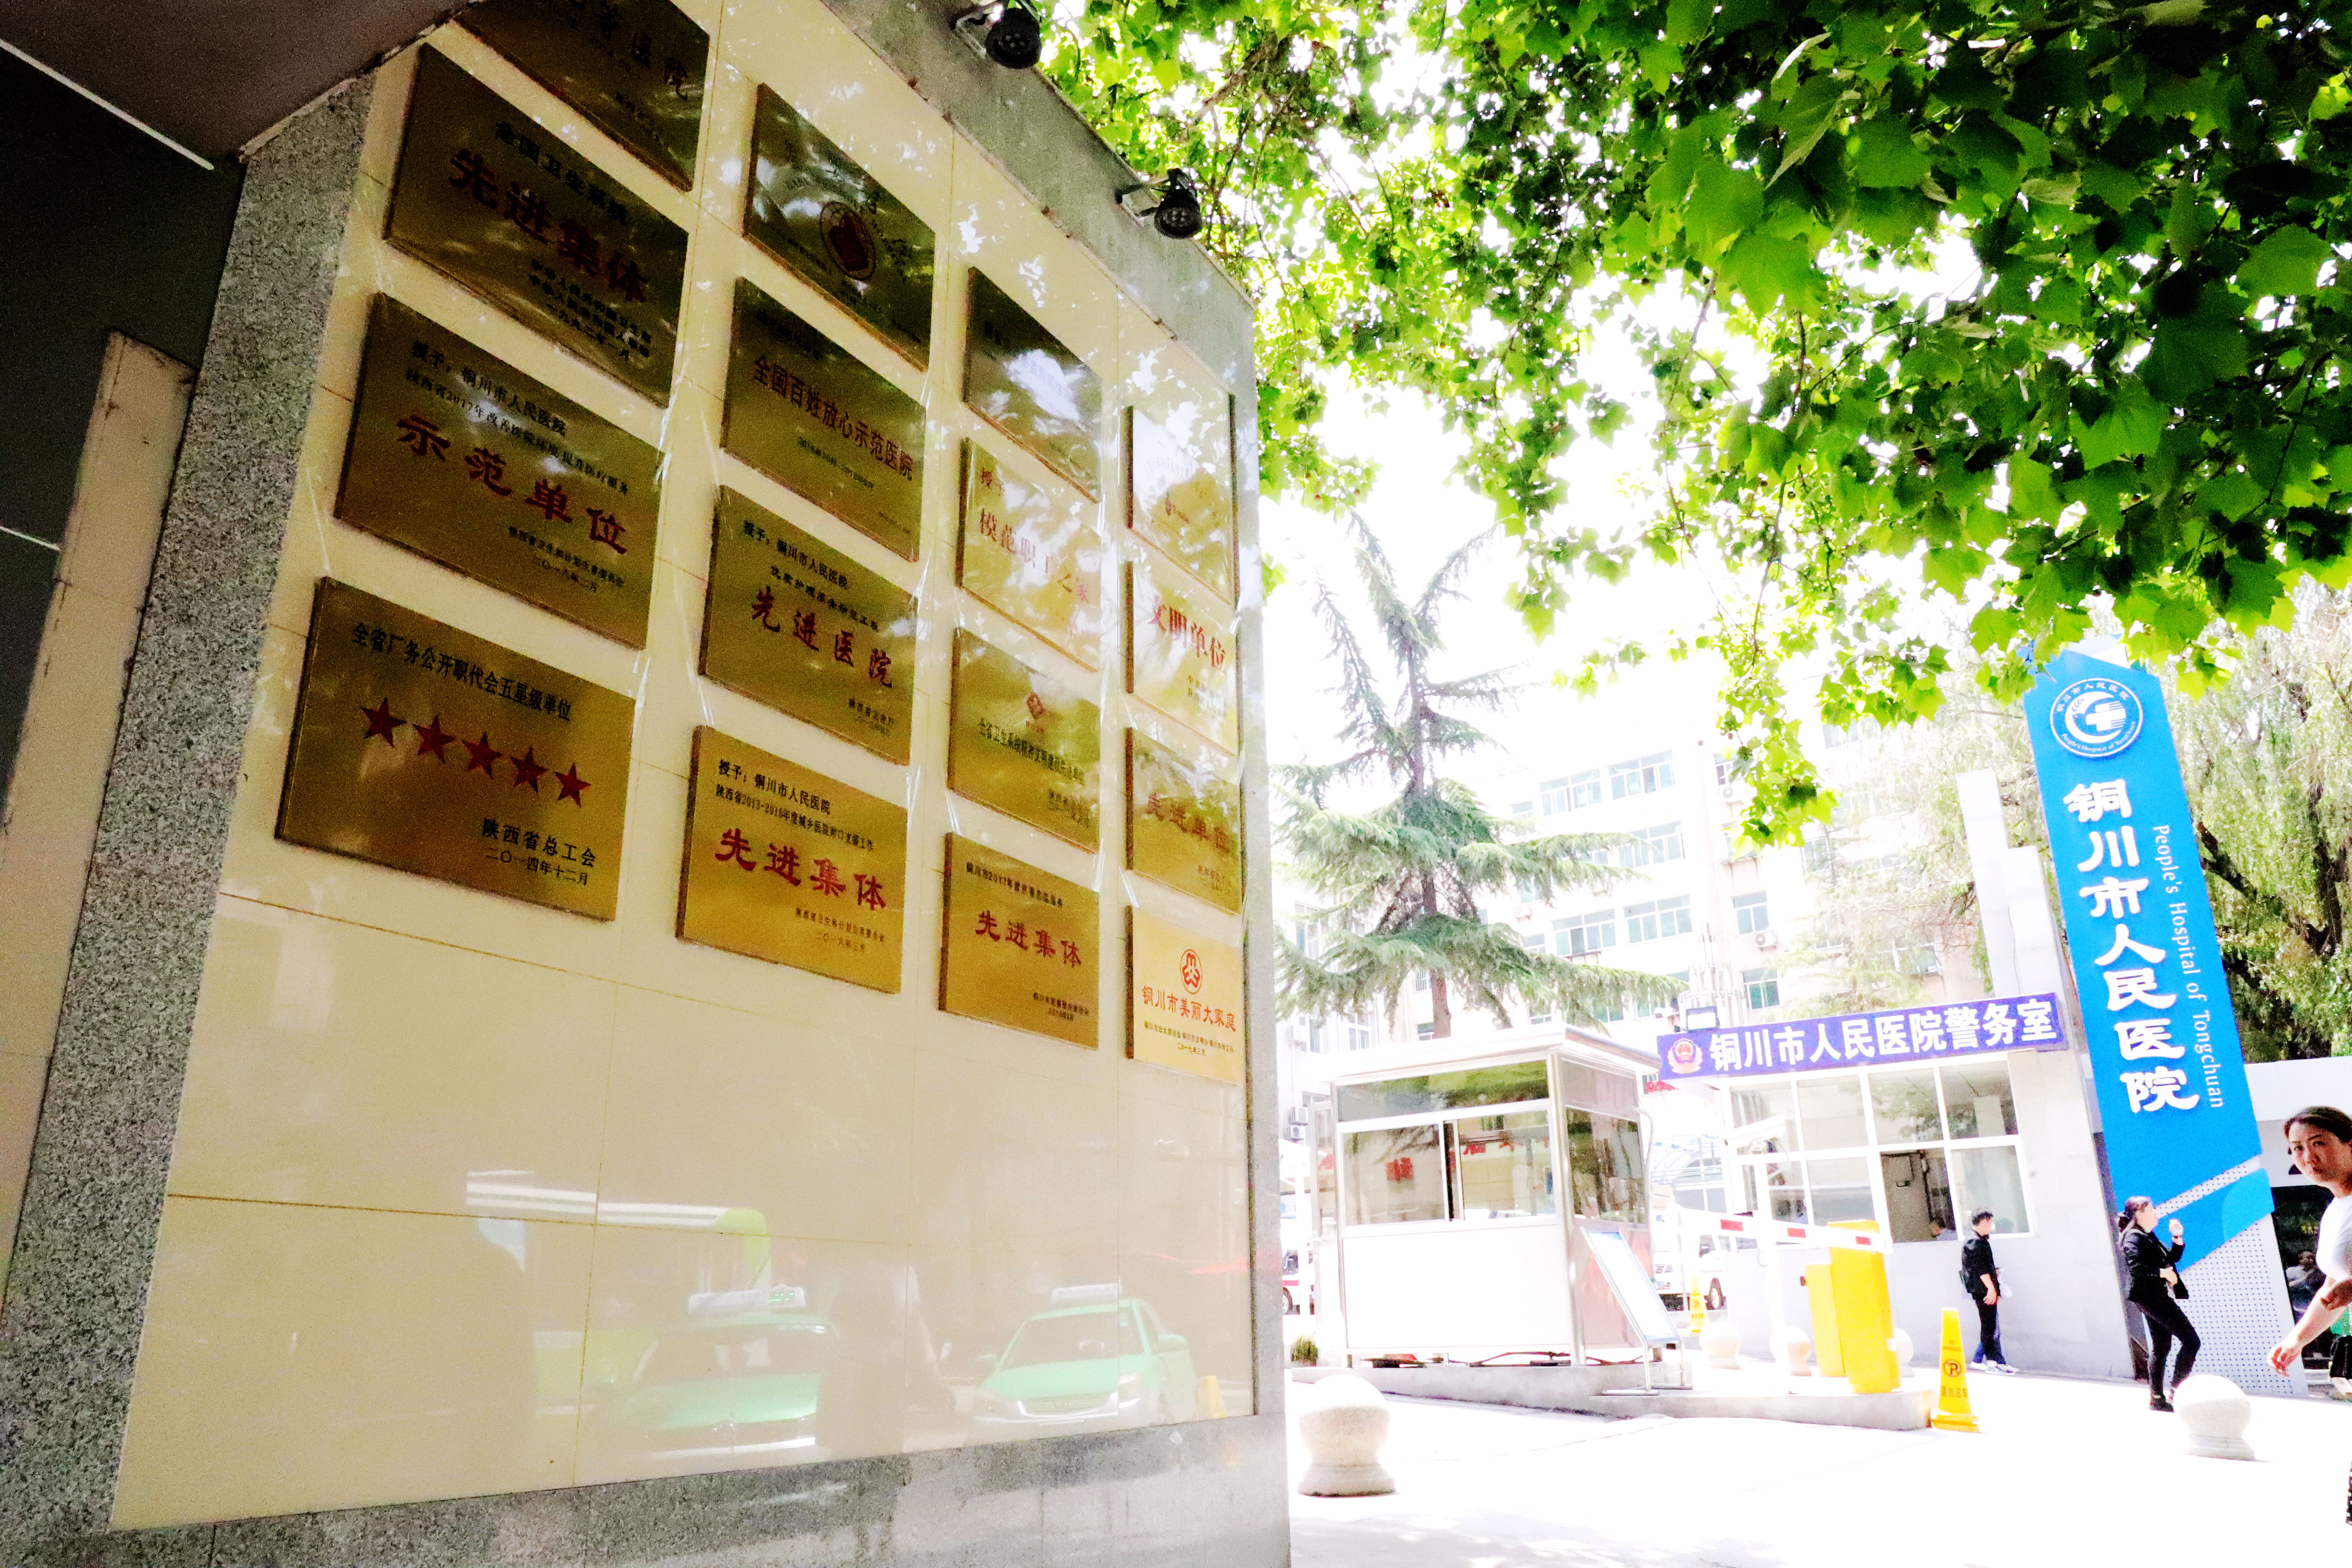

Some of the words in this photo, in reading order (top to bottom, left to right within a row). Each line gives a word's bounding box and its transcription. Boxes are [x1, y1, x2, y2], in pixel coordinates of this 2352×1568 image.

[493, 116, 628, 227] 全国卫生系统
[446, 140, 651, 312] 先进集体
[460, 363, 567, 438] 铜川市人民医院
[753, 351, 914, 483] 全国百姓放心示范医院
[394, 405, 631, 558] 示范单位
[776, 538, 848, 591] 铜川市人民医院
[351, 620, 574, 723] 全省厂务公开职代会五星级单位
[750, 577, 894, 690] 先进医院
[1147, 590, 1226, 676] 文明单位
[754, 771, 831, 816] 铜川市人民医院
[480, 815, 597, 869] 陕西省总工会
[715, 821, 887, 914] 先进集体
[2153, 825, 2179, 894] People's
[975, 905, 1082, 971] 先进集体
[2063, 779, 2200, 1113] 铜川市人民医院
[2169, 903, 2202, 975] Hospital
[1141, 984, 1236, 1032] 铜川市美丽大家庭
[2186, 982, 2208, 1003] of
[1709, 999, 2057, 1072] 铜川市人民医院警务室
[2192, 1011, 2224, 1109] Tongchuan
